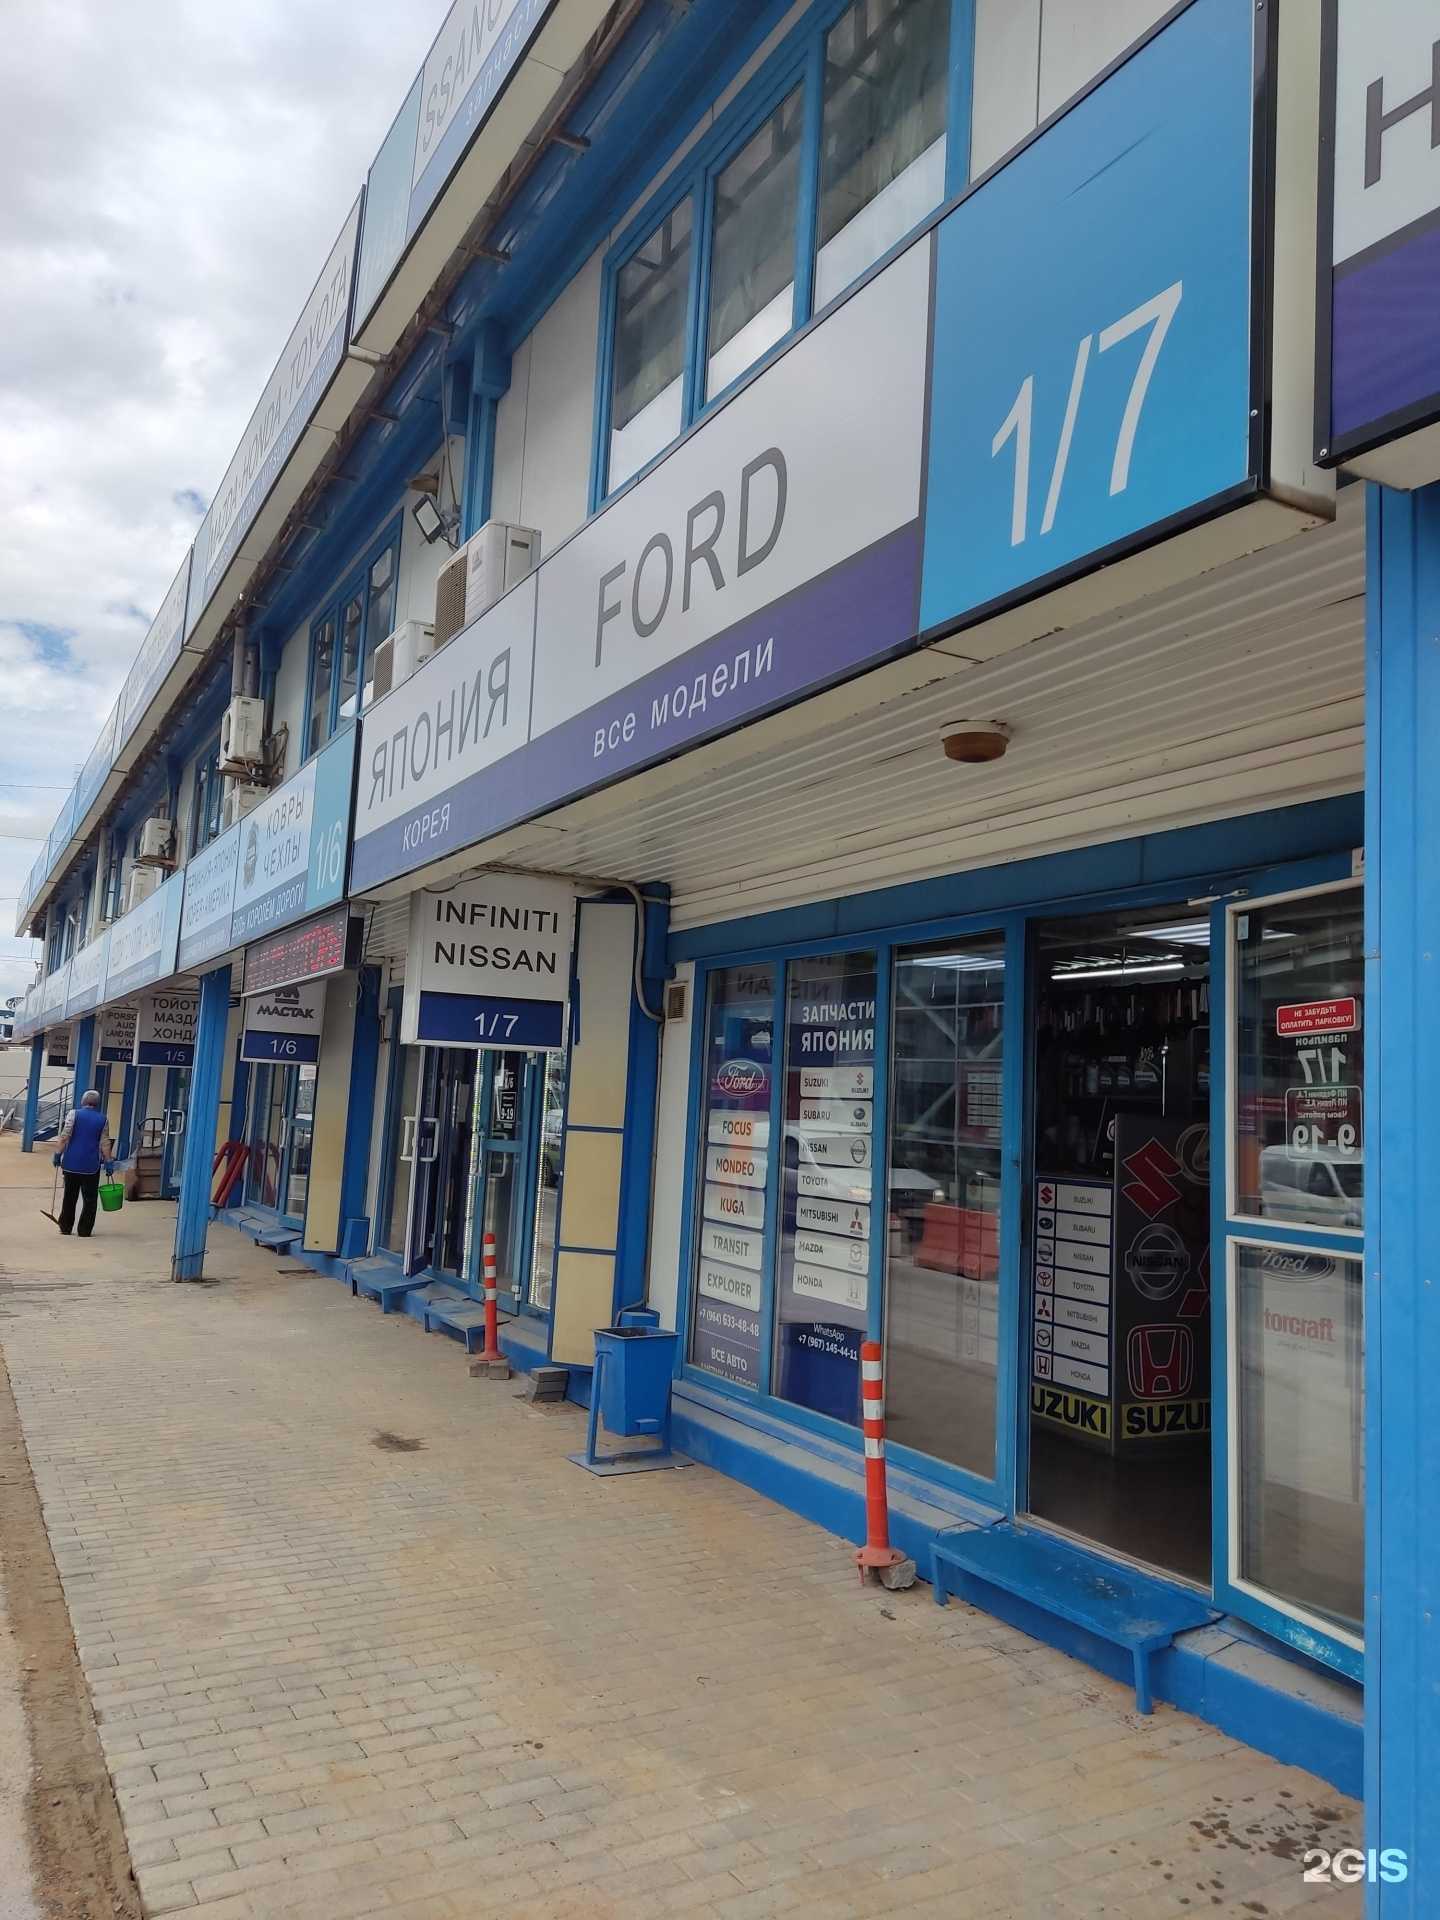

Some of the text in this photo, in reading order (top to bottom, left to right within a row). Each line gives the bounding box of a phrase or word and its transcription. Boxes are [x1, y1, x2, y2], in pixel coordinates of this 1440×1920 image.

[289, 255, 347, 405] TOYOTA
[991, 280, 1183, 547] 1/7
[595, 446, 788, 668] FORD
[594, 637, 775, 758] все модели
[368, 647, 511, 810] ЯПОНИЯ
[266, 791, 305, 839] КОВРЫ
[402, 803, 451, 853] КОРЕЯ
[263, 843, 300, 879] ЧЕХЛЫ
[316, 820, 343, 891] 1/6
[275, 881, 305, 921] ДОРОГИ
[436, 899, 559, 934] INFINITI
[434, 941, 556, 974] NISSAN
[256, 1005, 315, 1020] МАСТАК
[803, 1000, 875, 1023] ЗАПЧАСТИ
[1304, 1005, 1337, 1017] ЗАБУДЬТЕ
[473, 1012, 519, 1037] 1/7
[1281, 1015, 1352, 1030] ОПЛАТИТЬ ПАРКОВКУ!
[268, 1039, 297, 1055] 1/6
[802, 1029, 874, 1052] ЯПОНИЯ
[117, 1051, 132, 1061] 1/4
[165, 1050, 185, 1062] 1/5
[724, 1064, 758, 1091] Ford
[804, 1078, 829, 1088] SUZUKI
[500, 1107, 514, 1120] 9-19
[803, 1109, 831, 1120] SUBARU
[722, 1120, 752, 1136] FOCUS
[715, 1158, 755, 1176] MONDEO
[801, 1174, 828, 1187] TOYOTA
[719, 1197, 745, 1216] KUGA
[800, 1207, 839, 1223] MITSUBISHI
[1072, 1224, 1096, 1234] SUBARU
[712, 1234, 749, 1257] TRANSIT
[799, 1241, 824, 1254] MAZDA
[1132, 1255, 1186, 1269] NISSAN
[707, 1272, 752, 1298] EXPLORER
[797, 1273, 823, 1289] HONDA
[1072, 1282, 1095, 1293] TOYOTA
[698, 1308, 706, 1319] +7
[813, 1322, 845, 1343] WhatsApp
[798, 1334, 858, 1361] +7 (967) 145-44-11
[711, 1346, 747, 1371] ВСЕ АВТО
